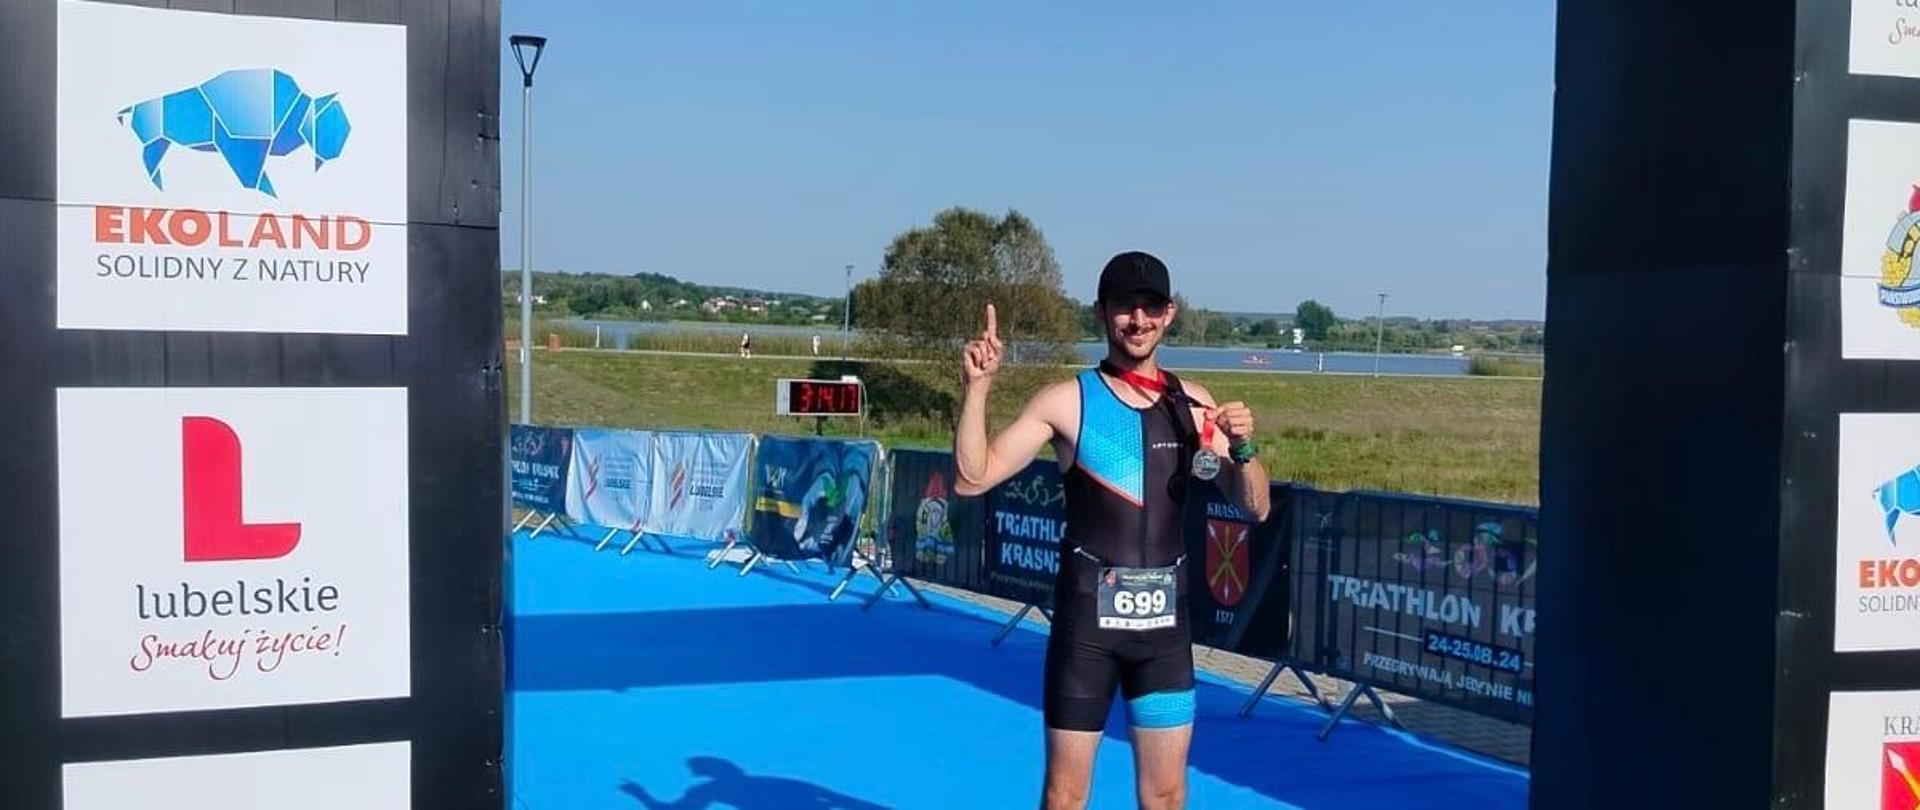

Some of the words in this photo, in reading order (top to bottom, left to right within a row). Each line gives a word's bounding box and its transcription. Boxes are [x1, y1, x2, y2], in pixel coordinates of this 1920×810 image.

[95, 205, 372, 252] EKOLAND
[97, 254, 223, 281] SOLIDNY
[233, 258, 248, 281] Z
[259, 259, 371, 284] NATURY
[136, 577, 339, 619] lubelskie
[1114, 589, 1167, 615] 699
[1859, 595, 1920, 613] SOLIDN
[130, 629, 249, 681] Smakuj
[256, 624, 347, 672] życie!
